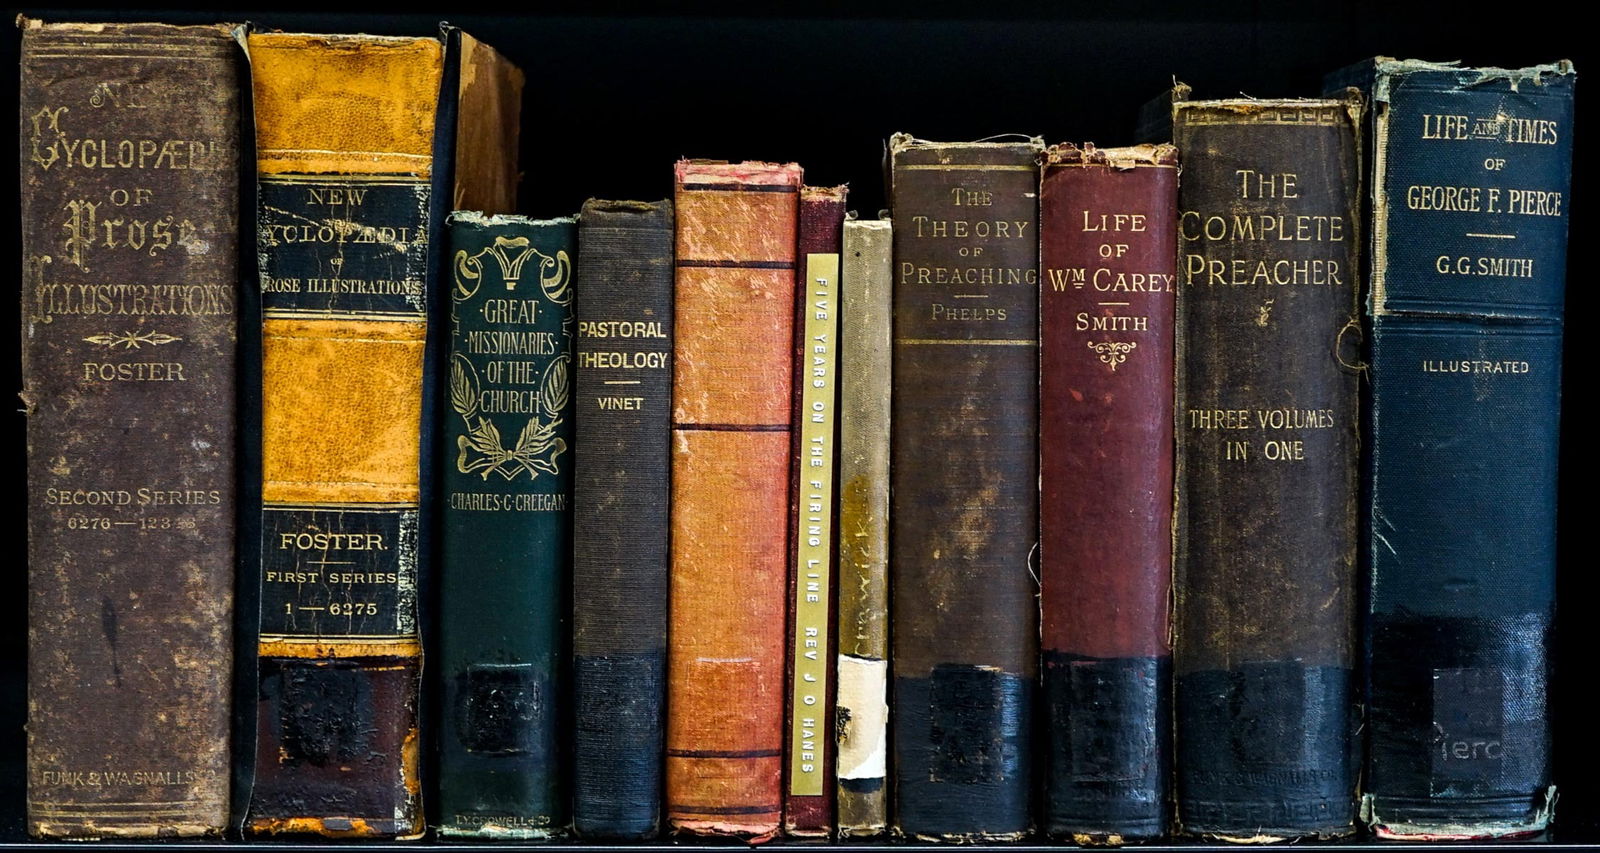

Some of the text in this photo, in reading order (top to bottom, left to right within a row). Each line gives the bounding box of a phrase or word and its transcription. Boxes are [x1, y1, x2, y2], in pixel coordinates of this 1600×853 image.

[1422, 113, 1558, 145] LIFE AND TIMES
[1484, 157, 1506, 171] OF
[1235, 169, 1298, 199] THE
[109, 189, 153, 207] OF
[307, 188, 368, 206] NEW
[951, 187, 993, 207] THE
[1407, 185, 1562, 217] GEORGE F. PIERCE
[912, 215, 1029, 239] THEORY
[1082, 210, 1147, 233] LIFE
[1181, 210, 1344, 242] COMPLETE
[63, 199, 198, 273] Prose
[266, 224, 428, 246] YCLOPÆDIA
[958, 246, 984, 258] OF
[1099, 244, 1130, 259] OF
[901, 262, 1037, 286] PREACHING
[1186, 253, 1344, 286] PREACHER
[30, 255, 234, 324] ILLUSTRATIONS
[306, 278, 422, 296] ILLUSTRATIONS
[931, 303, 1008, 322] PHELPS
[1076, 312, 1148, 332] SMITH
[578, 321, 668, 338] PASTORAL
[578, 352, 668, 369] THEOLOGY
[1423, 360, 1530, 374] ILLUSTRATED
[83, 363, 186, 381] FOSTER
[597, 397, 644, 410] VINET
[1189, 409, 1335, 430] THREE VOLUMES
[1226, 440, 1305, 461] IN ONE
[46, 488, 221, 506] SECOND SERIES
[800, 278, 828, 773] FIVE YEARS ON THE FIRING LINE REV J O HANES
[280, 533, 388, 551] FOSTER.
[266, 571, 397, 585] FIRST SERIES
[42, 771, 84, 786] FUNK
[87, 772, 101, 786] &
[104, 771, 194, 786] WAGNALLS
